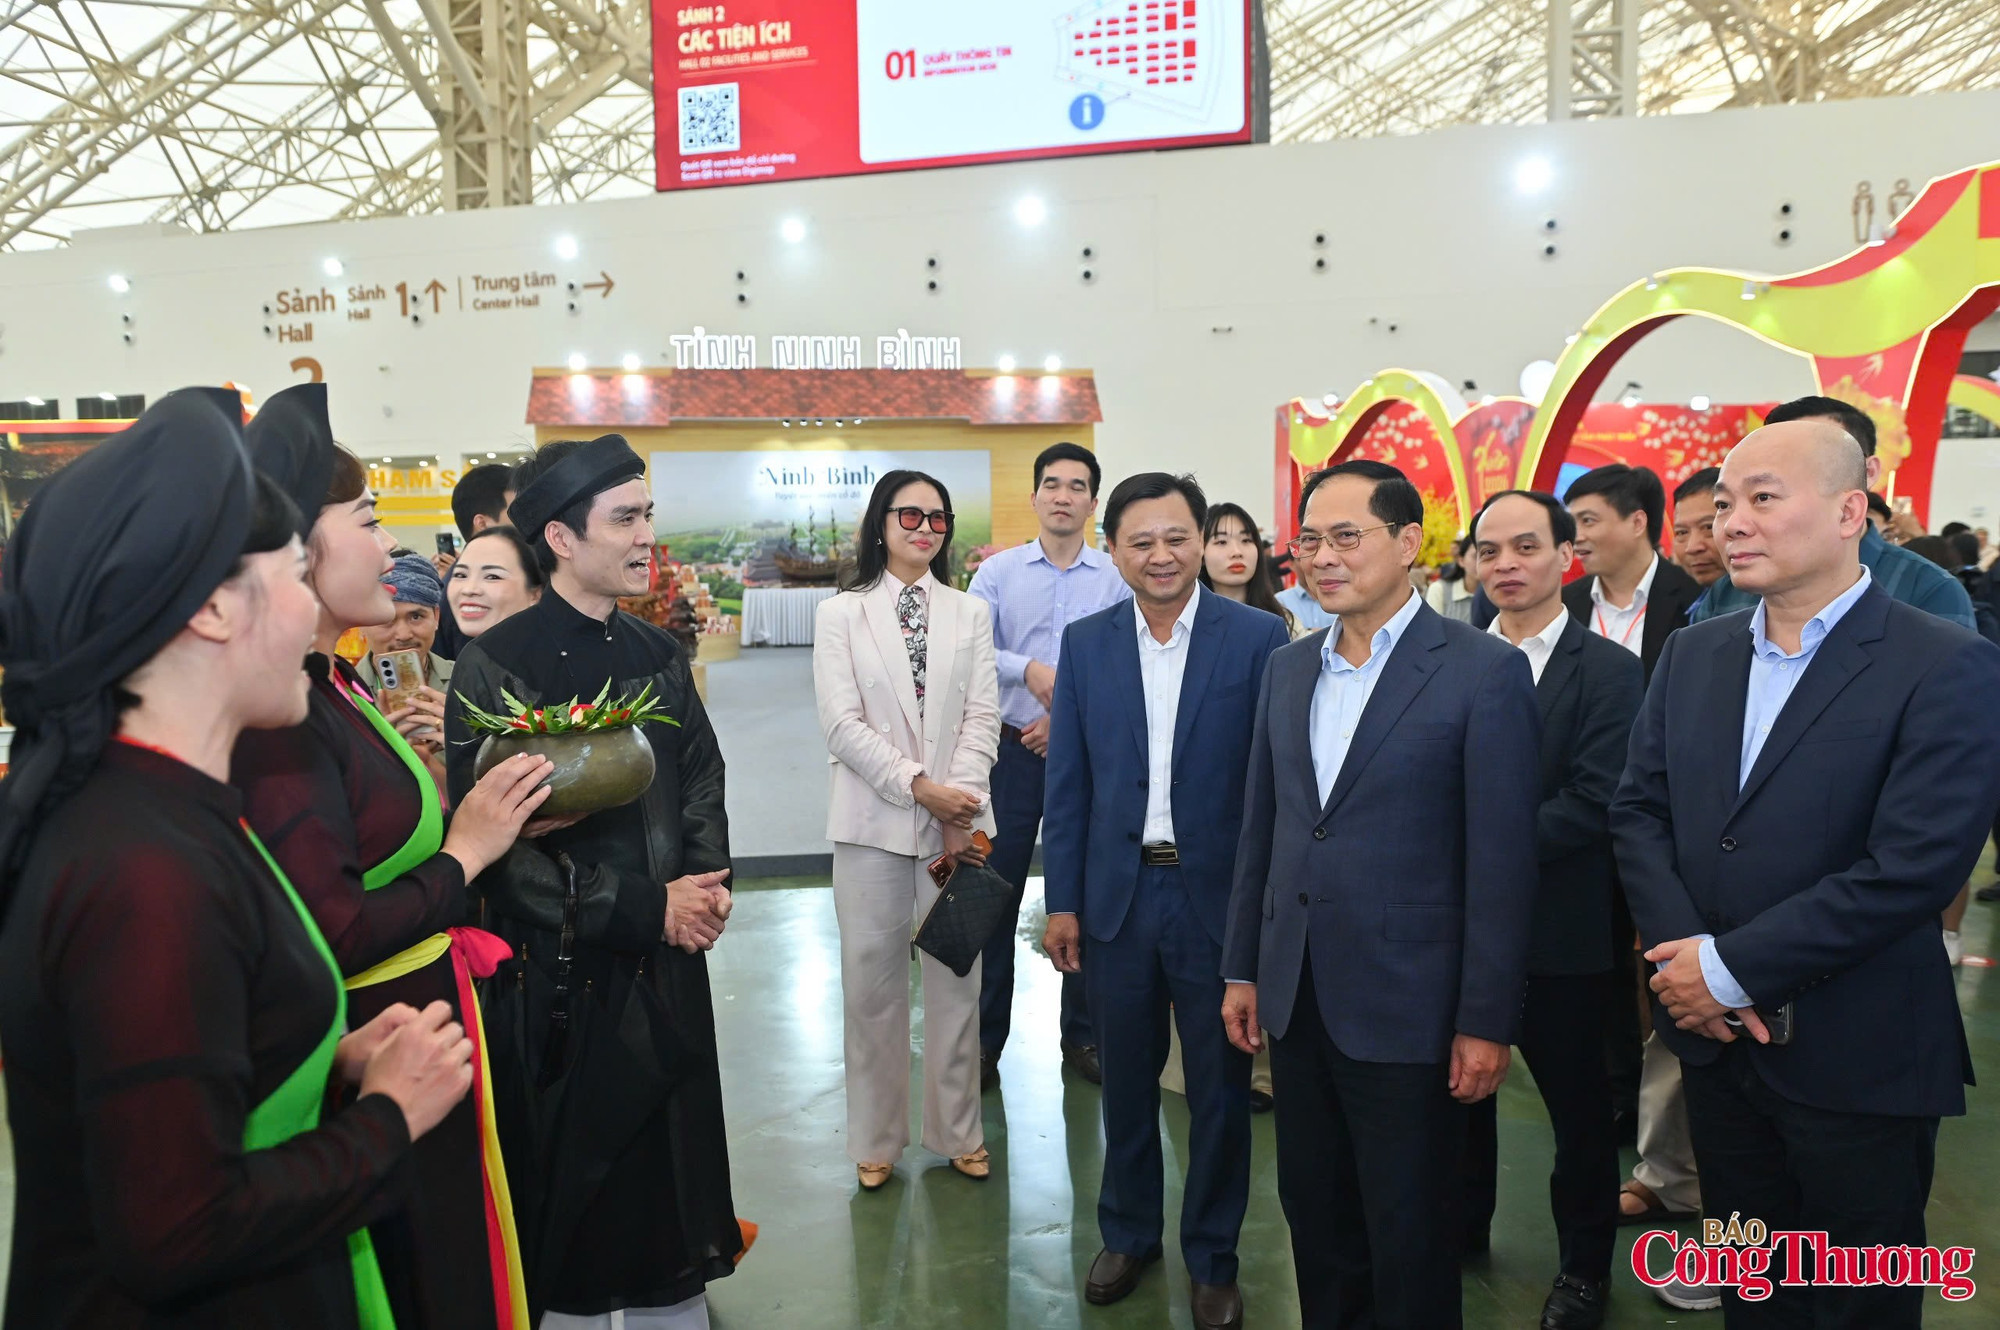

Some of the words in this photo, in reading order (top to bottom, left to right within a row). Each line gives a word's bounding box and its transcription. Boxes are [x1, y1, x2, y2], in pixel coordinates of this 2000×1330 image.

[715, 5, 725, 22] 2
[678, 27, 714, 53] CÁC
[717, 22, 756, 50] TIỆN
[759, 20, 791, 45] ÍCH
[771, 46, 808, 60] SERVICES
[886, 49, 916, 80] 01
[472, 273, 521, 293] Trung
[524, 271, 557, 289] tâm
[276, 286, 336, 315] Sảnh
[347, 284, 387, 303] Sảnh
[395, 282, 409, 317] 1
[472, 298, 512, 311] Center
[515, 295, 540, 308] Hall
[347, 307, 371, 322] Hall
[277, 322, 313, 344] Hall
[670, 326, 756, 369] TỈNH
[772, 335, 861, 370] NINH
[876, 328, 961, 370] BÌNH
[760, 466, 815, 485] Ninh
